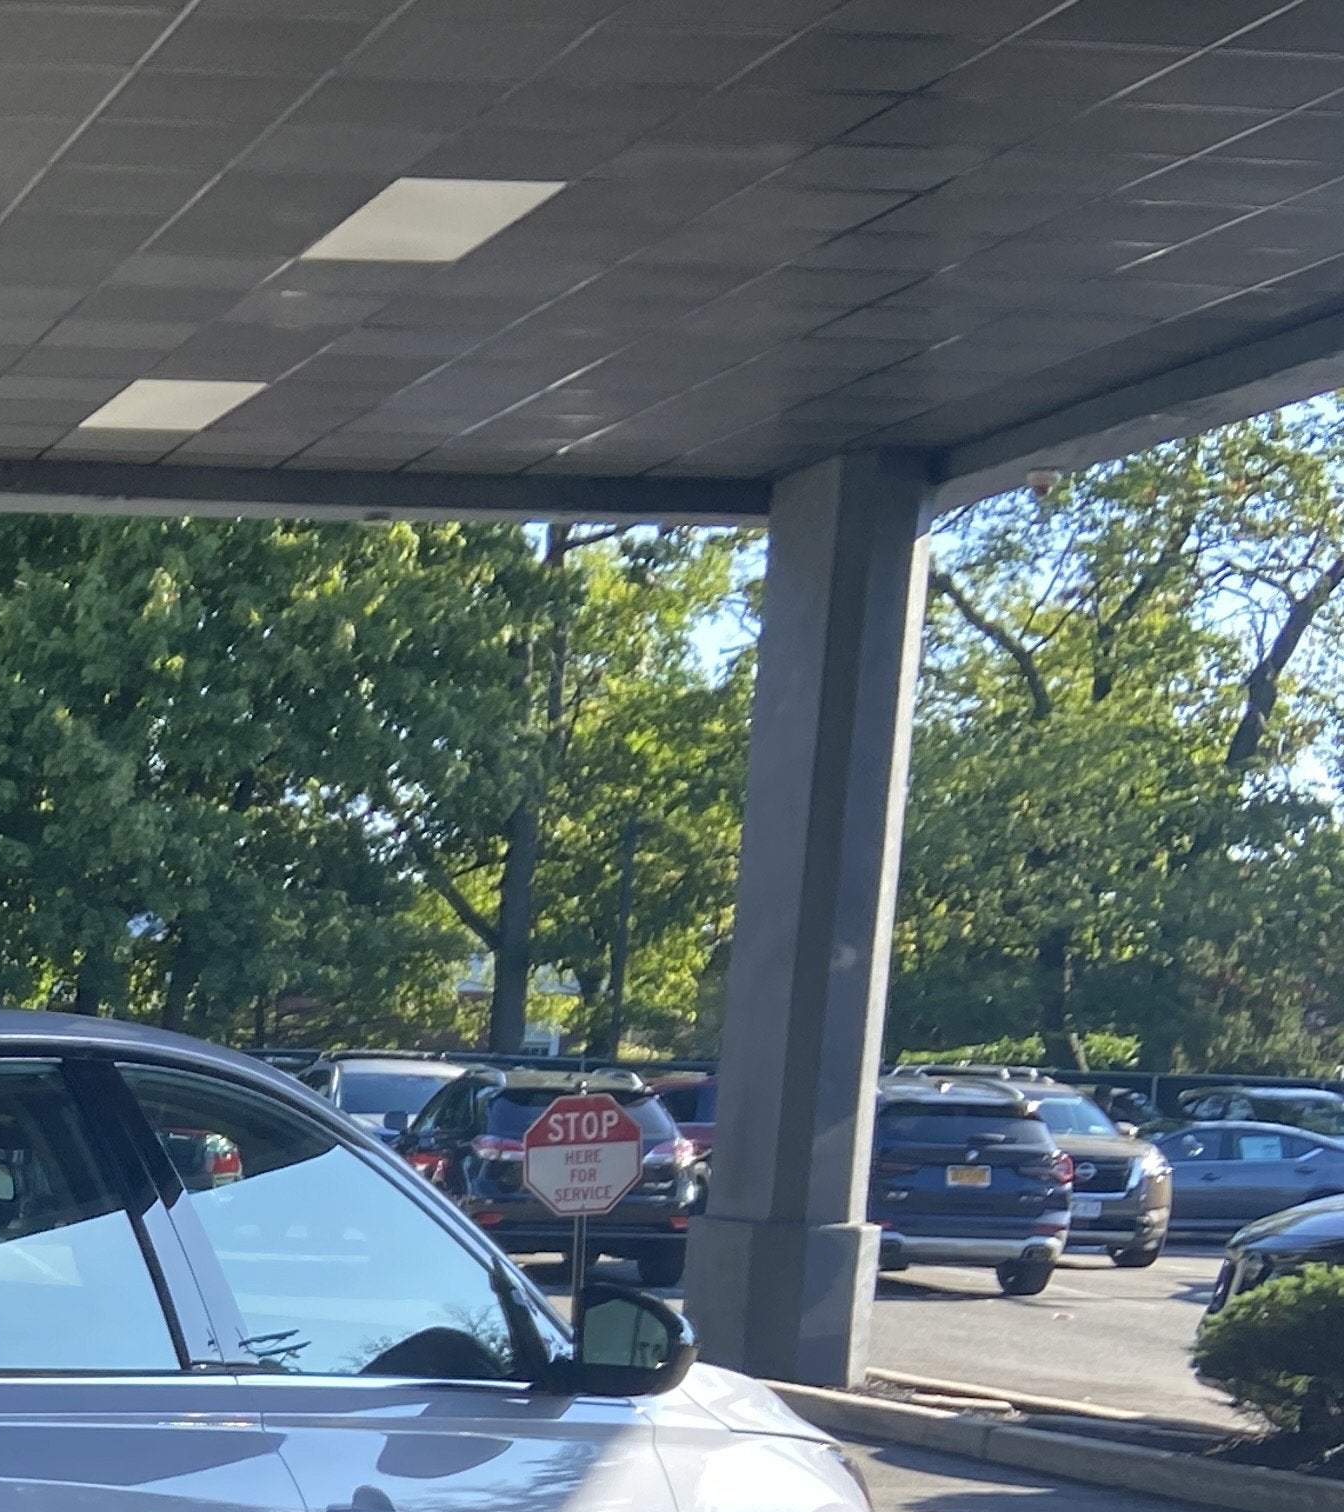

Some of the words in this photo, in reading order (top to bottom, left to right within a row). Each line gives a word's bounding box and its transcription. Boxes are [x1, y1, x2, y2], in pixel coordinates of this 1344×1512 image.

[548, 1110, 619, 1142] STOP
[565, 1148, 602, 1165] HERE
[570, 1167, 597, 1183] FOR
[554, 1184, 613, 1203] SERVICE
